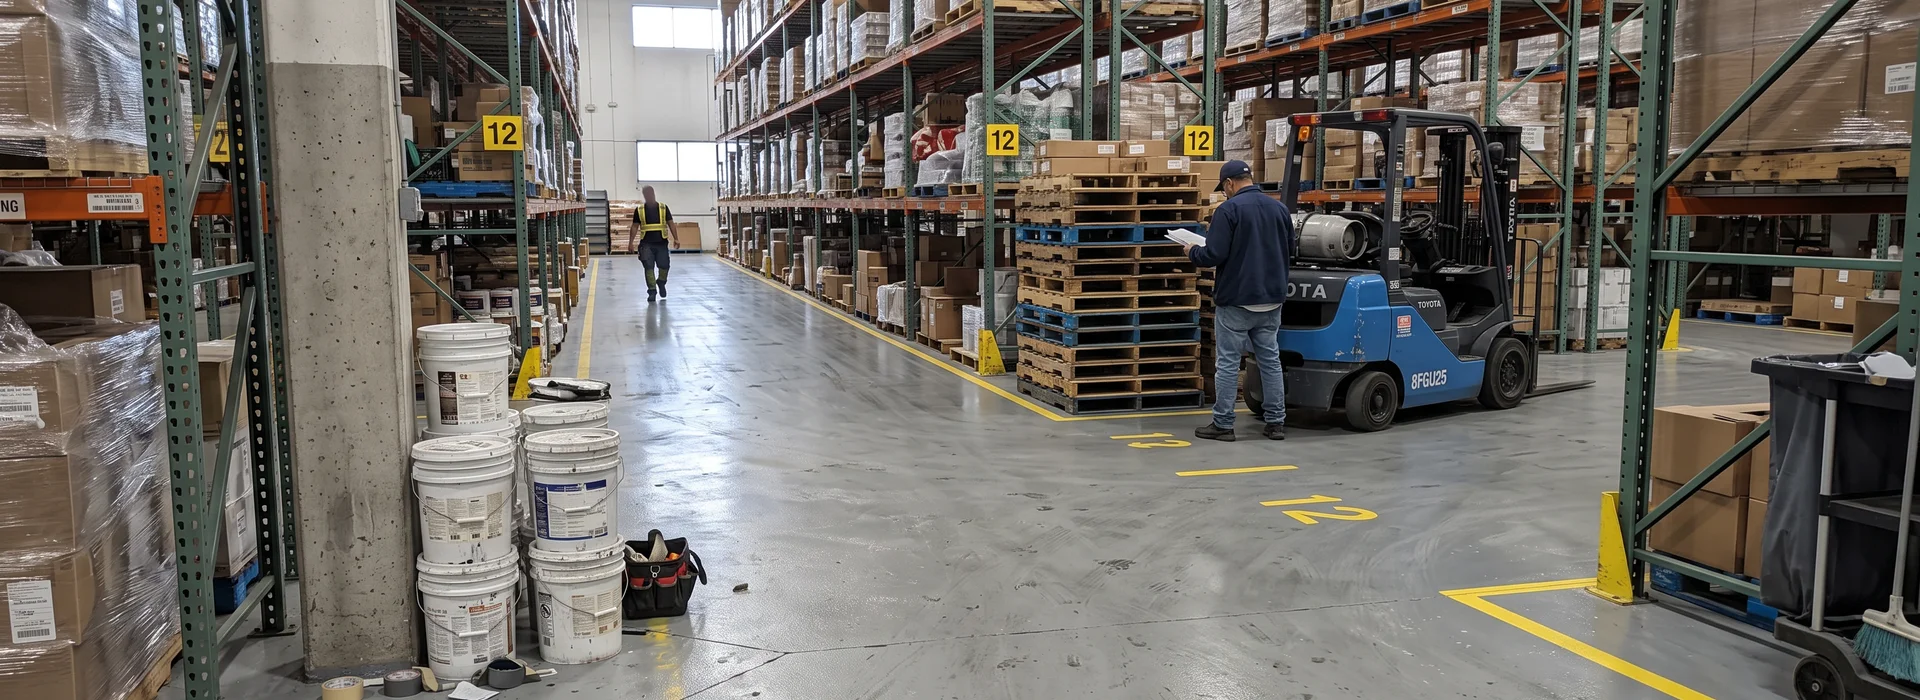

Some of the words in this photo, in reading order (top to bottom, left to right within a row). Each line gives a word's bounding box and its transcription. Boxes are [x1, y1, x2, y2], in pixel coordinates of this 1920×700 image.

[214, 129, 227, 155] 2
[488, 122, 517, 145] 12
[992, 130, 1015, 150] 12
[1188, 131, 1209, 150] 12
[1, 200, 19, 212] NG
[1418, 300, 1441, 308] TOYOTA
[1411, 369, 1447, 390] 8FGU25
[1259, 494, 1378, 525] 12
